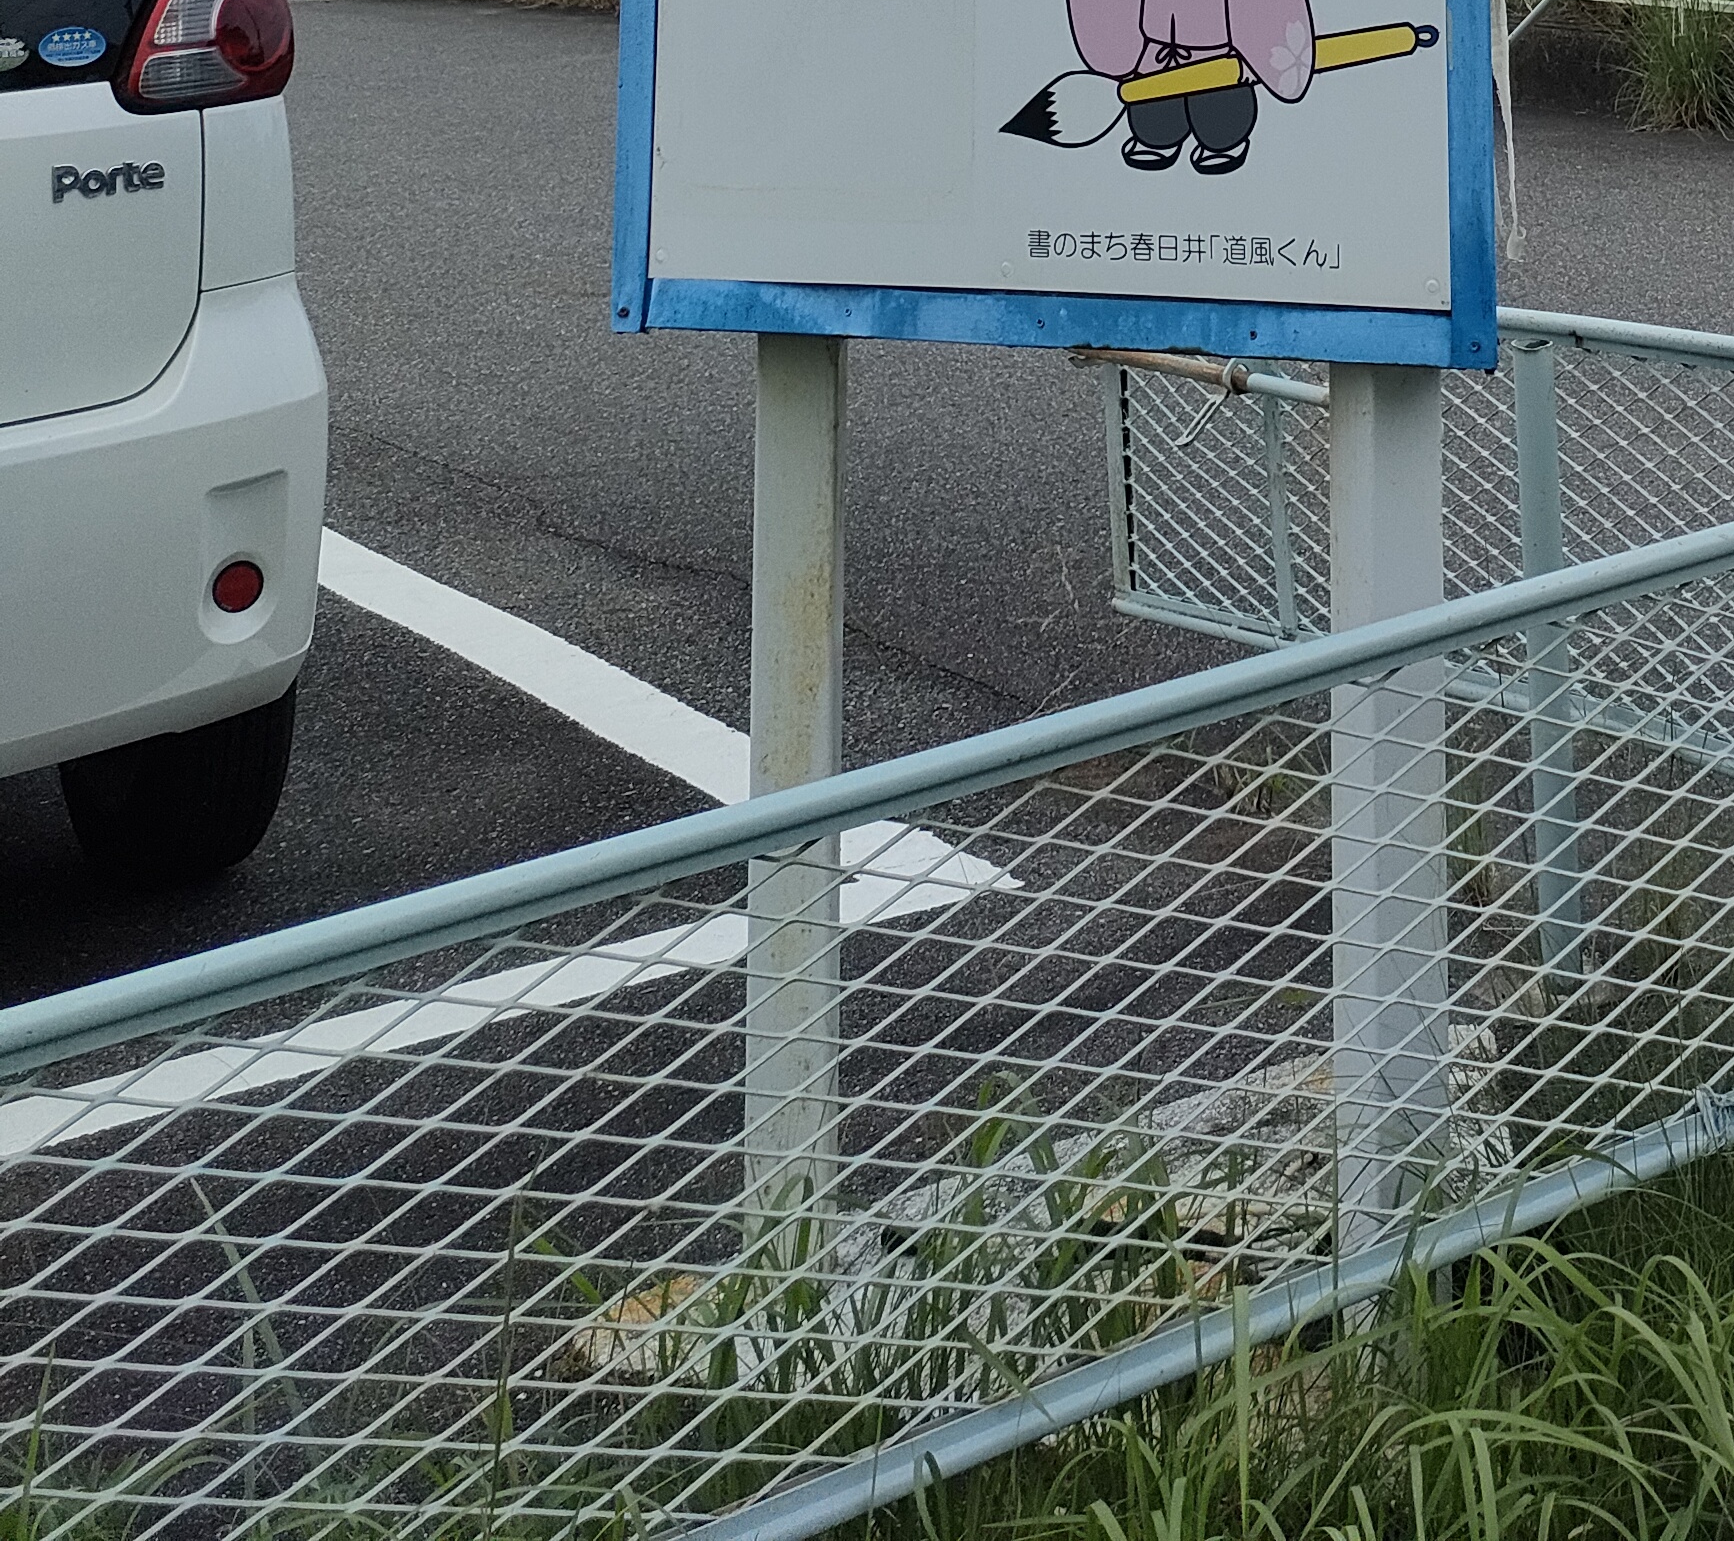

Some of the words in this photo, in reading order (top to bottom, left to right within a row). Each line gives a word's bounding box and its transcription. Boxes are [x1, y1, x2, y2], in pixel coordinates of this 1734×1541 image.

[51, 160, 166, 204] Porte
[1027, 229, 1342, 270] 書のまち春日井「道風くん」
